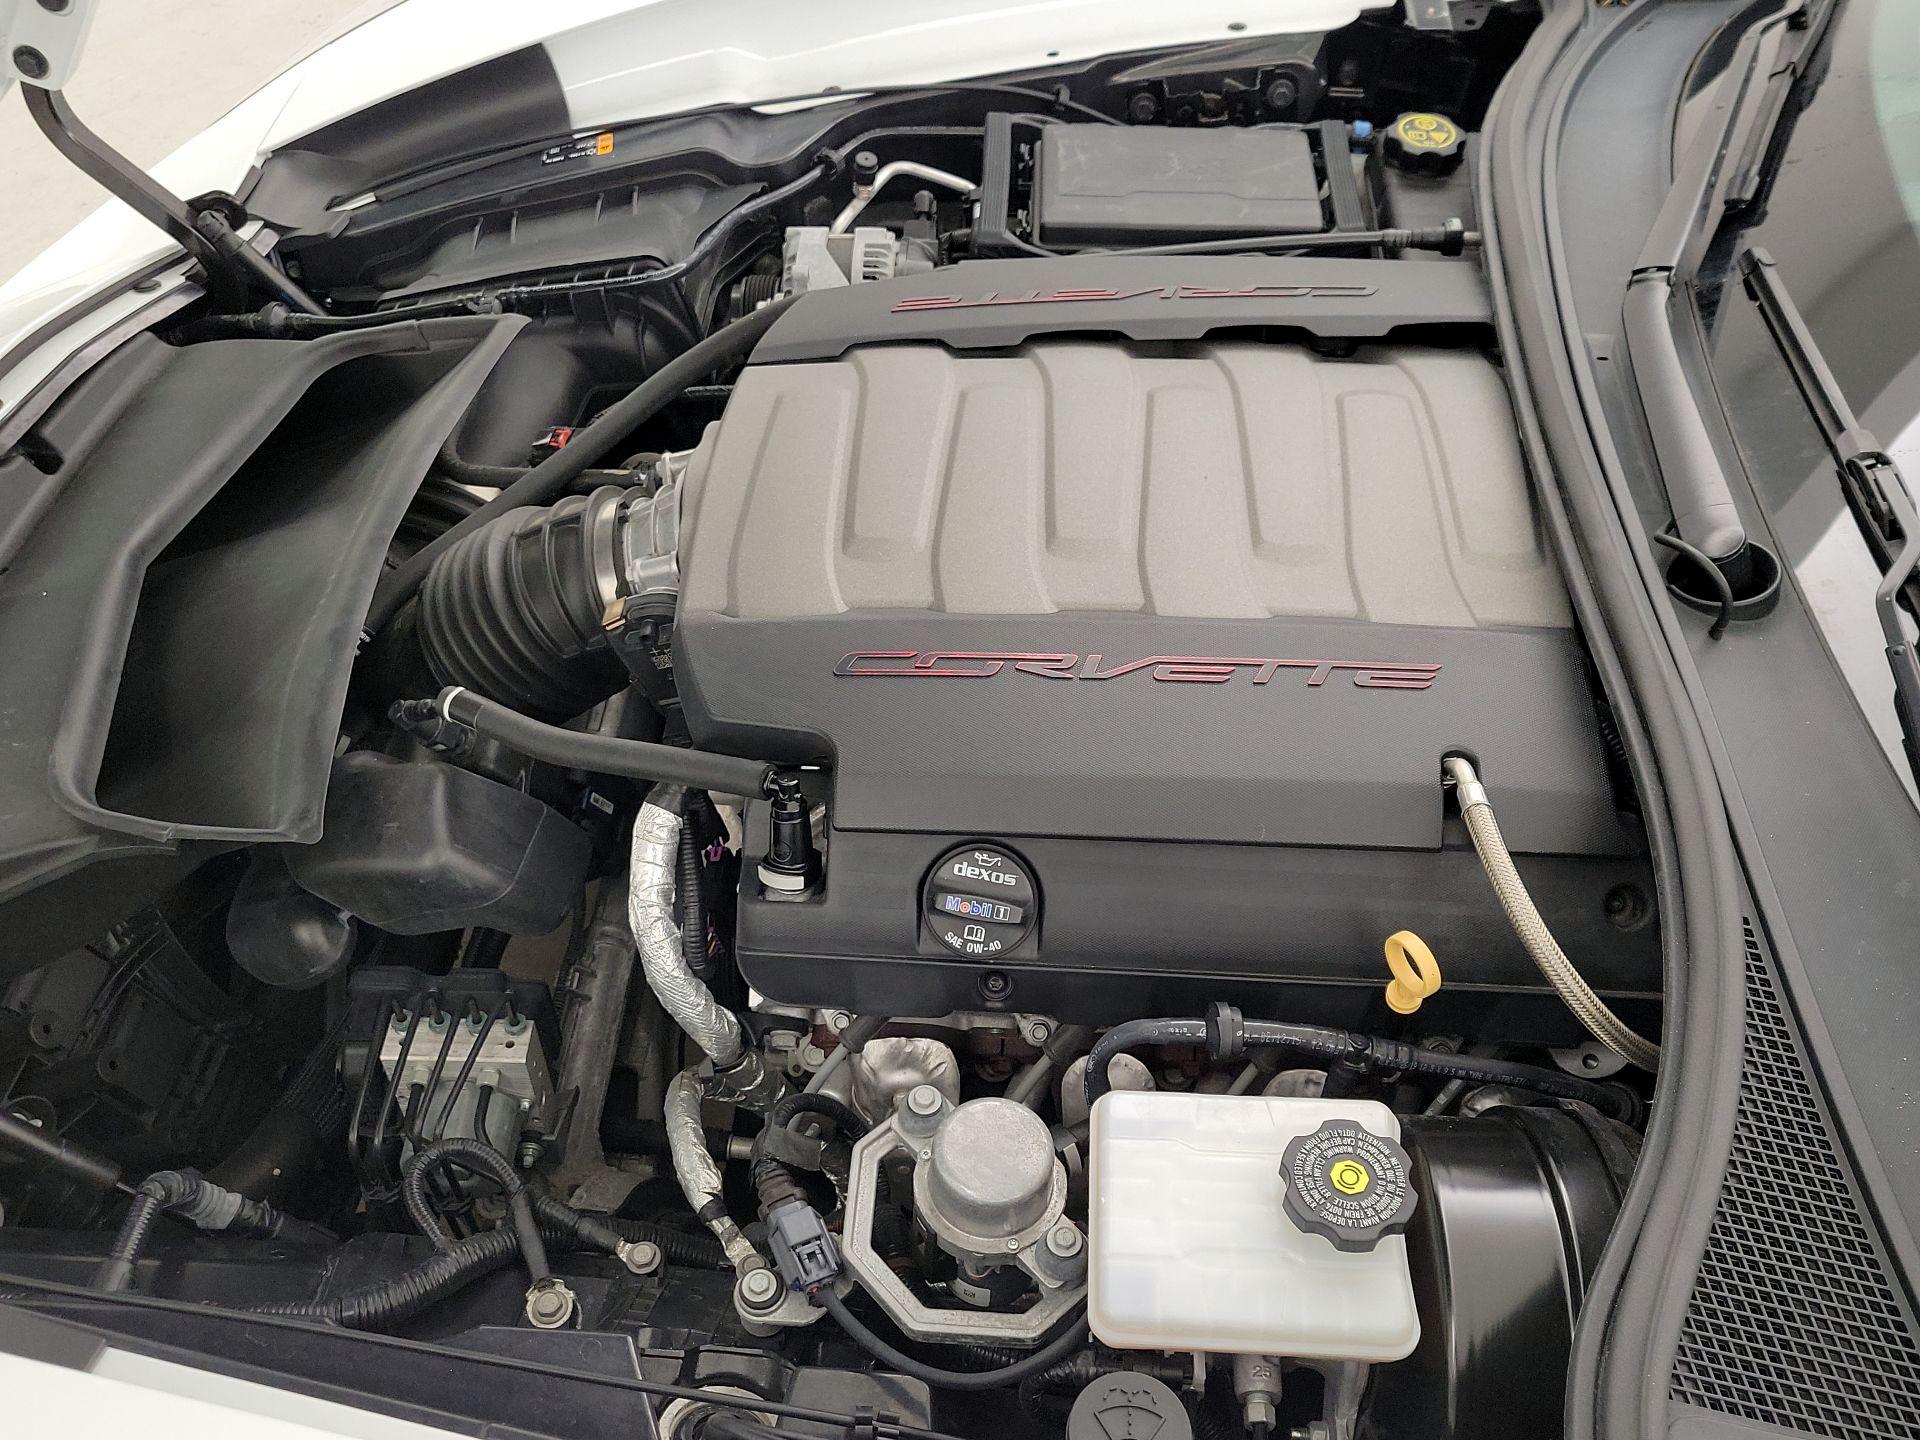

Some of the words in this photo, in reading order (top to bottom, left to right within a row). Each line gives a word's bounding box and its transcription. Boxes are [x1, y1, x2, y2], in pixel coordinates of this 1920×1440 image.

[891, 285, 1379, 313] CORVETTE
[833, 650, 1442, 689] CORVETTE
[953, 861, 1018, 886] dexos
[945, 895, 992, 918] Mobil
[944, 931, 963, 949] SAE
[966, 940, 1002, 954] 0W-40
[1302, 1135, 1321, 1151] FROM
[1317, 1137, 1342, 1151] BEFORE
[1318, 1129, 1338, 1141] FLUID
[1343, 1137, 1356, 1146] CAP
[1357, 1132, 1391, 1157] ATTENTION:
[1294, 1152, 1306, 1175] SEALED
[1356, 1148, 1386, 1179] PROVENANT
[1357, 1141, 1391, 1169] N'EMPLOYER
[1314, 1157, 1326, 1177] CLEAN
[1385, 1170, 1396, 1182] QUE
[1390, 1157, 1406, 1187] NETTOYER
[1294, 1175, 1317, 1210] CONTAINER.
[1304, 1177, 1316, 1190] USE
[1314, 1177, 1331, 1199] FILLER
[1386, 1183, 1396, 1193] DU
[1396, 1187, 1406, 1197] LE
[1310, 1189, 1326, 1205] ONLY
[1360, 1193, 1380, 1209] BIDON
[1373, 1192, 1393, 1213] LIQUIDE
[1320, 1208, 1346, 1226] DEPOSE
[1344, 1210, 1364, 1219] FREIN
[1364, 1208, 1375, 1217] DE
[1379, 1195, 1402, 1221] BOUCHON
[1347, 1219, 1357, 1228] LA
[1360, 1215, 1380, 1228] AVANT
